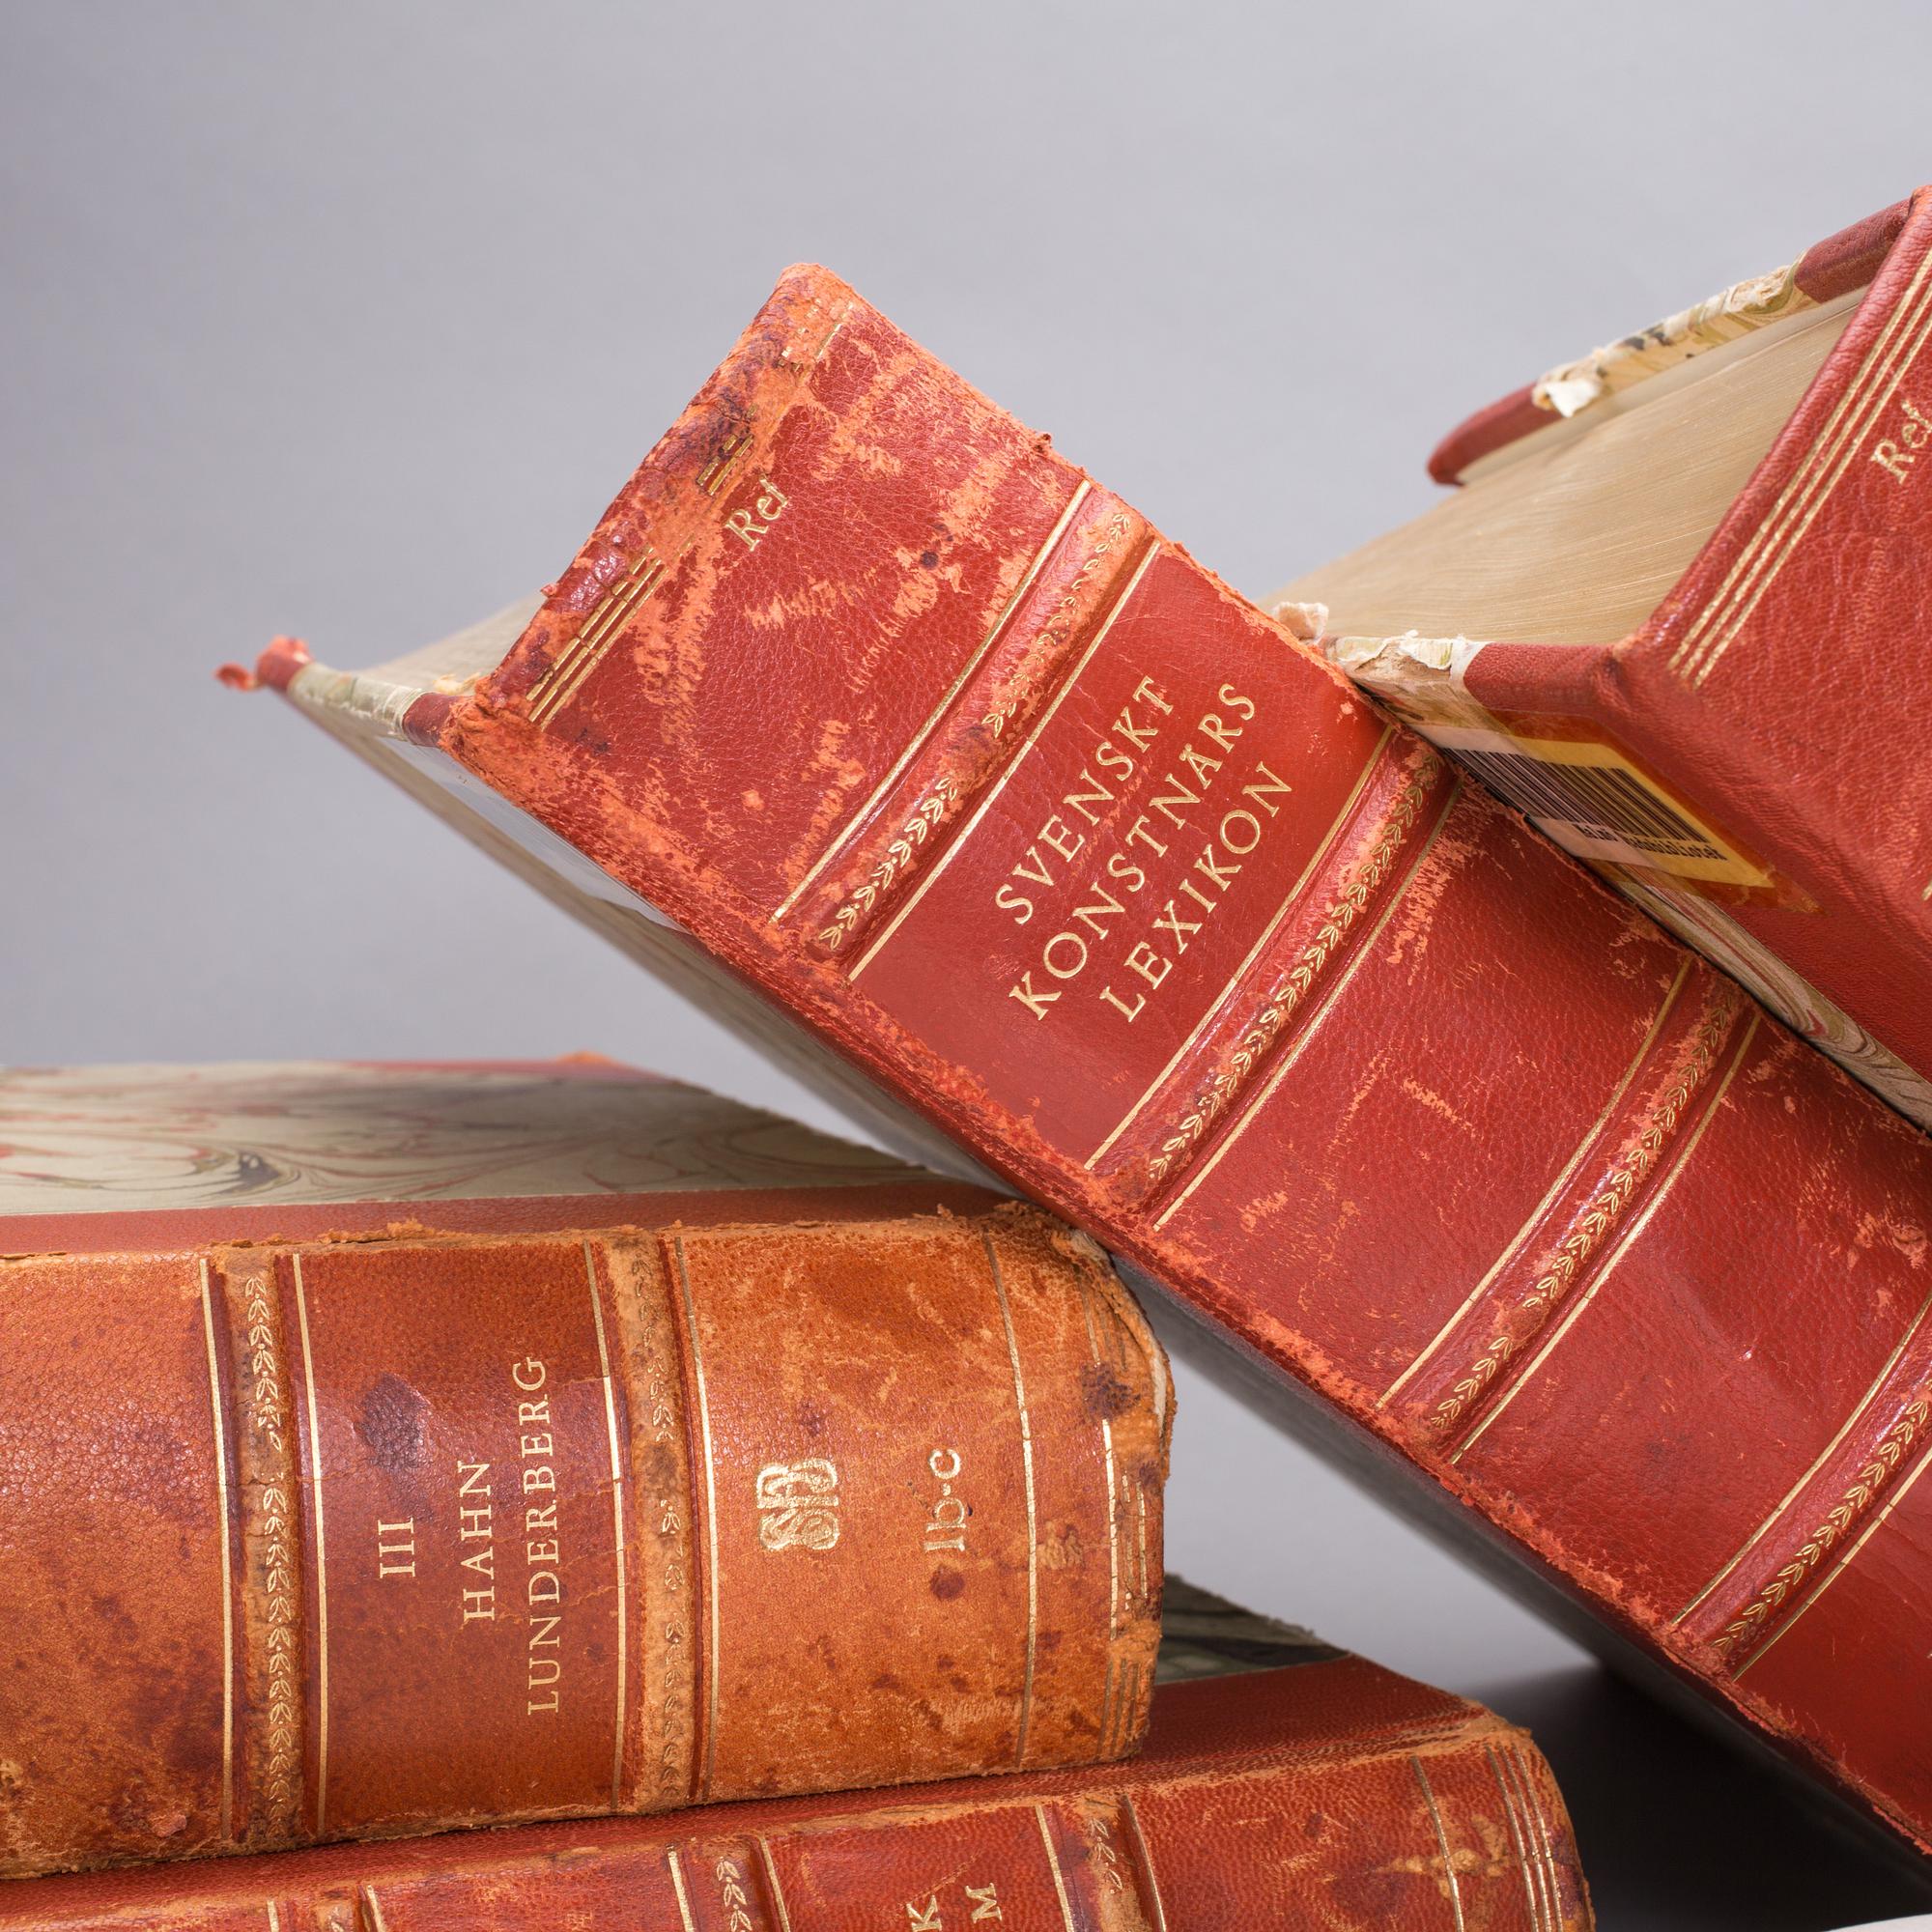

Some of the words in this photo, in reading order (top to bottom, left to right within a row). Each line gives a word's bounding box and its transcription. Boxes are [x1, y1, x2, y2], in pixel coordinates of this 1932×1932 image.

[1870, 399, 1932, 484] Ref
[995, 676, 1173, 924] SVENSKT
[1009, 684, 1255, 1020] KONSTNÄRS
[1099, 761, 1293, 1022] LEXIKON
[377, 1517, 416, 1578] III
[457, 1461, 495, 1622] HAHN
[512, 1356, 561, 1716] LUNDERBERG
